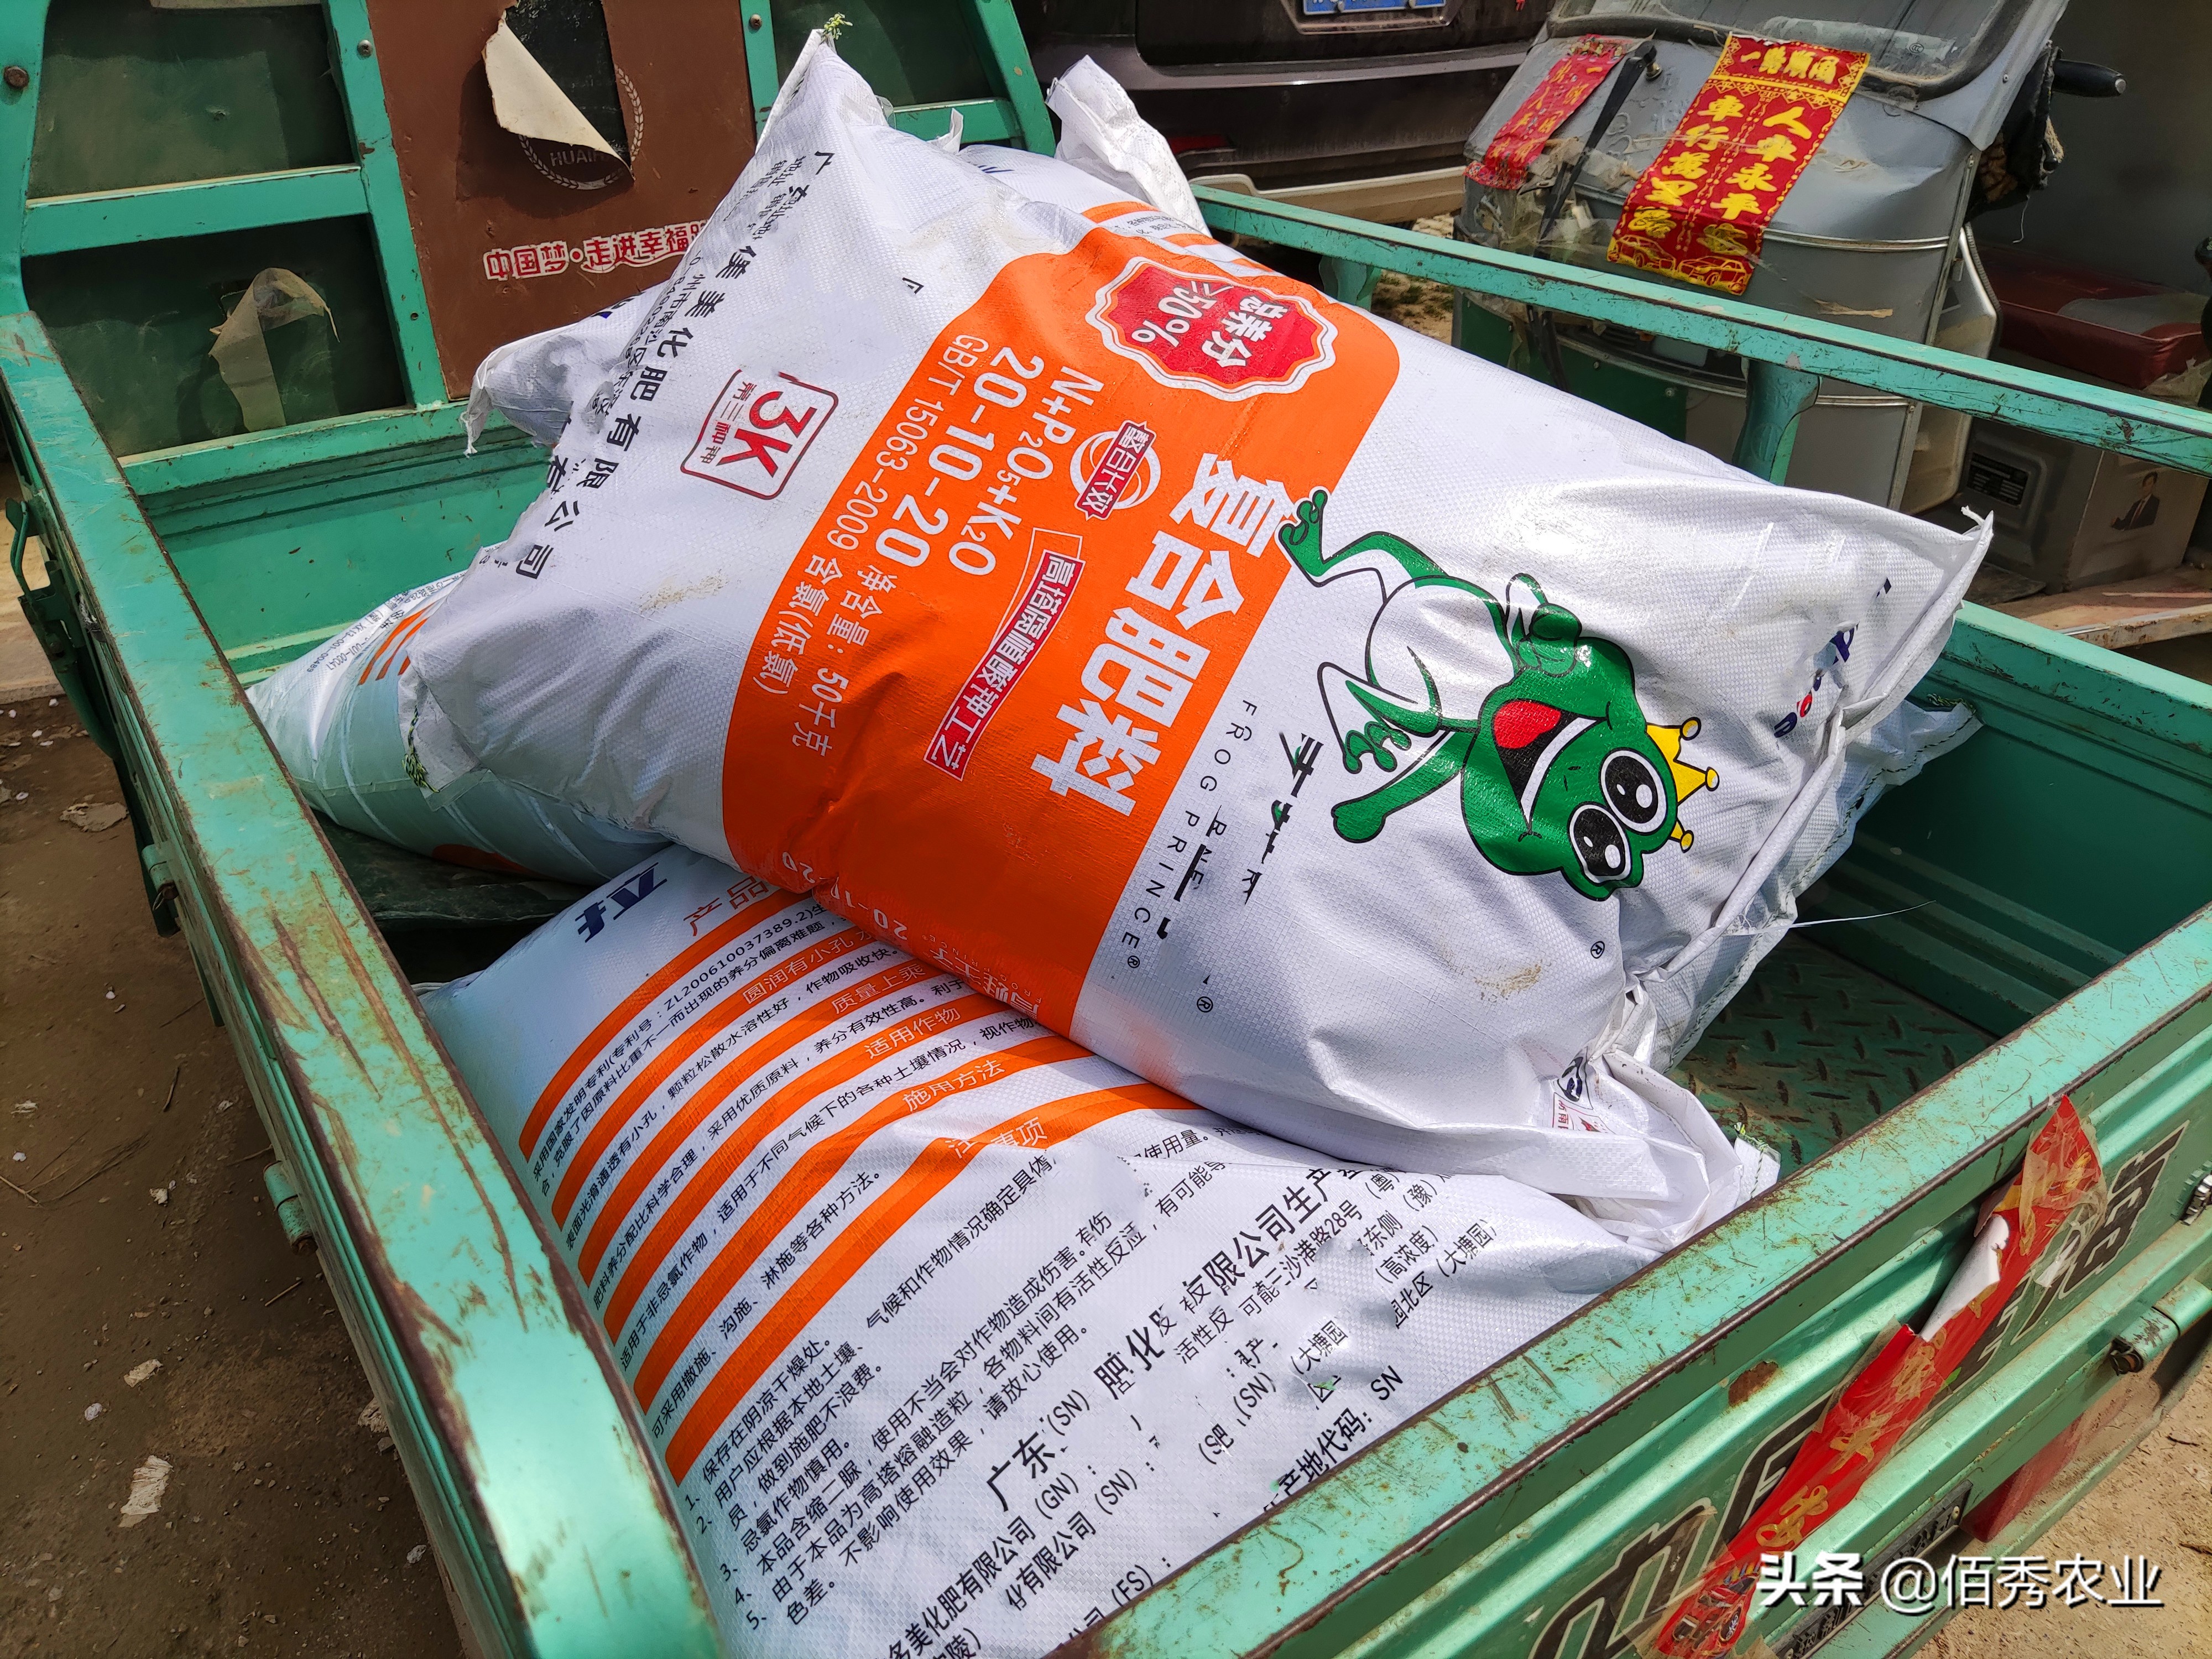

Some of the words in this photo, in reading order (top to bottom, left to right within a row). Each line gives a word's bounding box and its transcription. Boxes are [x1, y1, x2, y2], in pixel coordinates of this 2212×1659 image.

[927, 333, 989, 397] GB/T
[1202, 295, 1288, 367] 总养分
[715, 390, 818, 479] 3K
[875, 347, 1045, 568] 20-10-20
[827, 396, 944, 551] 15063-2009
[931, 554, 1077, 771] 高塔腐植酸钾工艺
[1031, 453, 1297, 817] 复合肥料
[831, 963, 926, 1014] 质量上乘
[863, 1005, 961, 1060] 适用作物
[902, 1059, 1005, 1112] 施用方法
[944, 1115, 1048, 1159] 注事项
